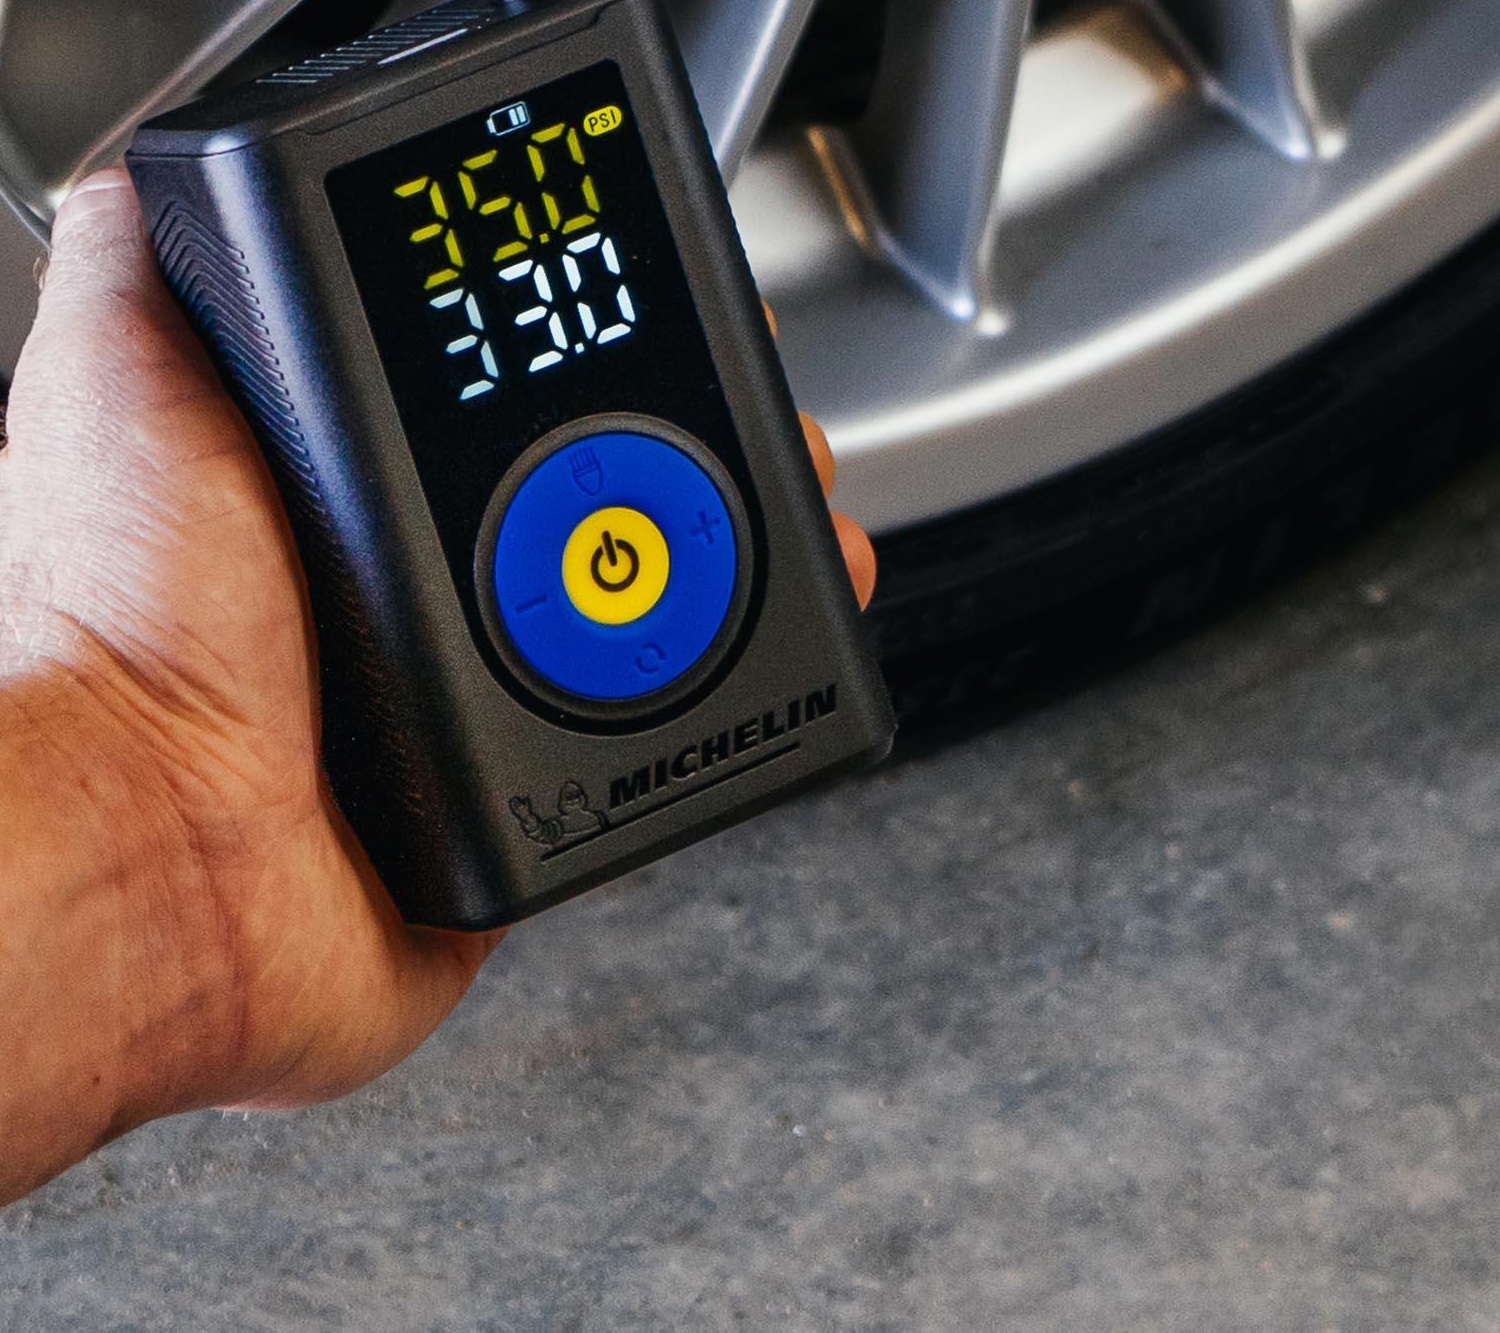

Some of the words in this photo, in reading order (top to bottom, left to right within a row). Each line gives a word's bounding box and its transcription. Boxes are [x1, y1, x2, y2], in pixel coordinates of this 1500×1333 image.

[588, 111, 617, 133] PSI
[393, 122, 601, 291] 35.0
[428, 232, 636, 402] 33.0
[609, 683, 837, 811] MICHELIN
